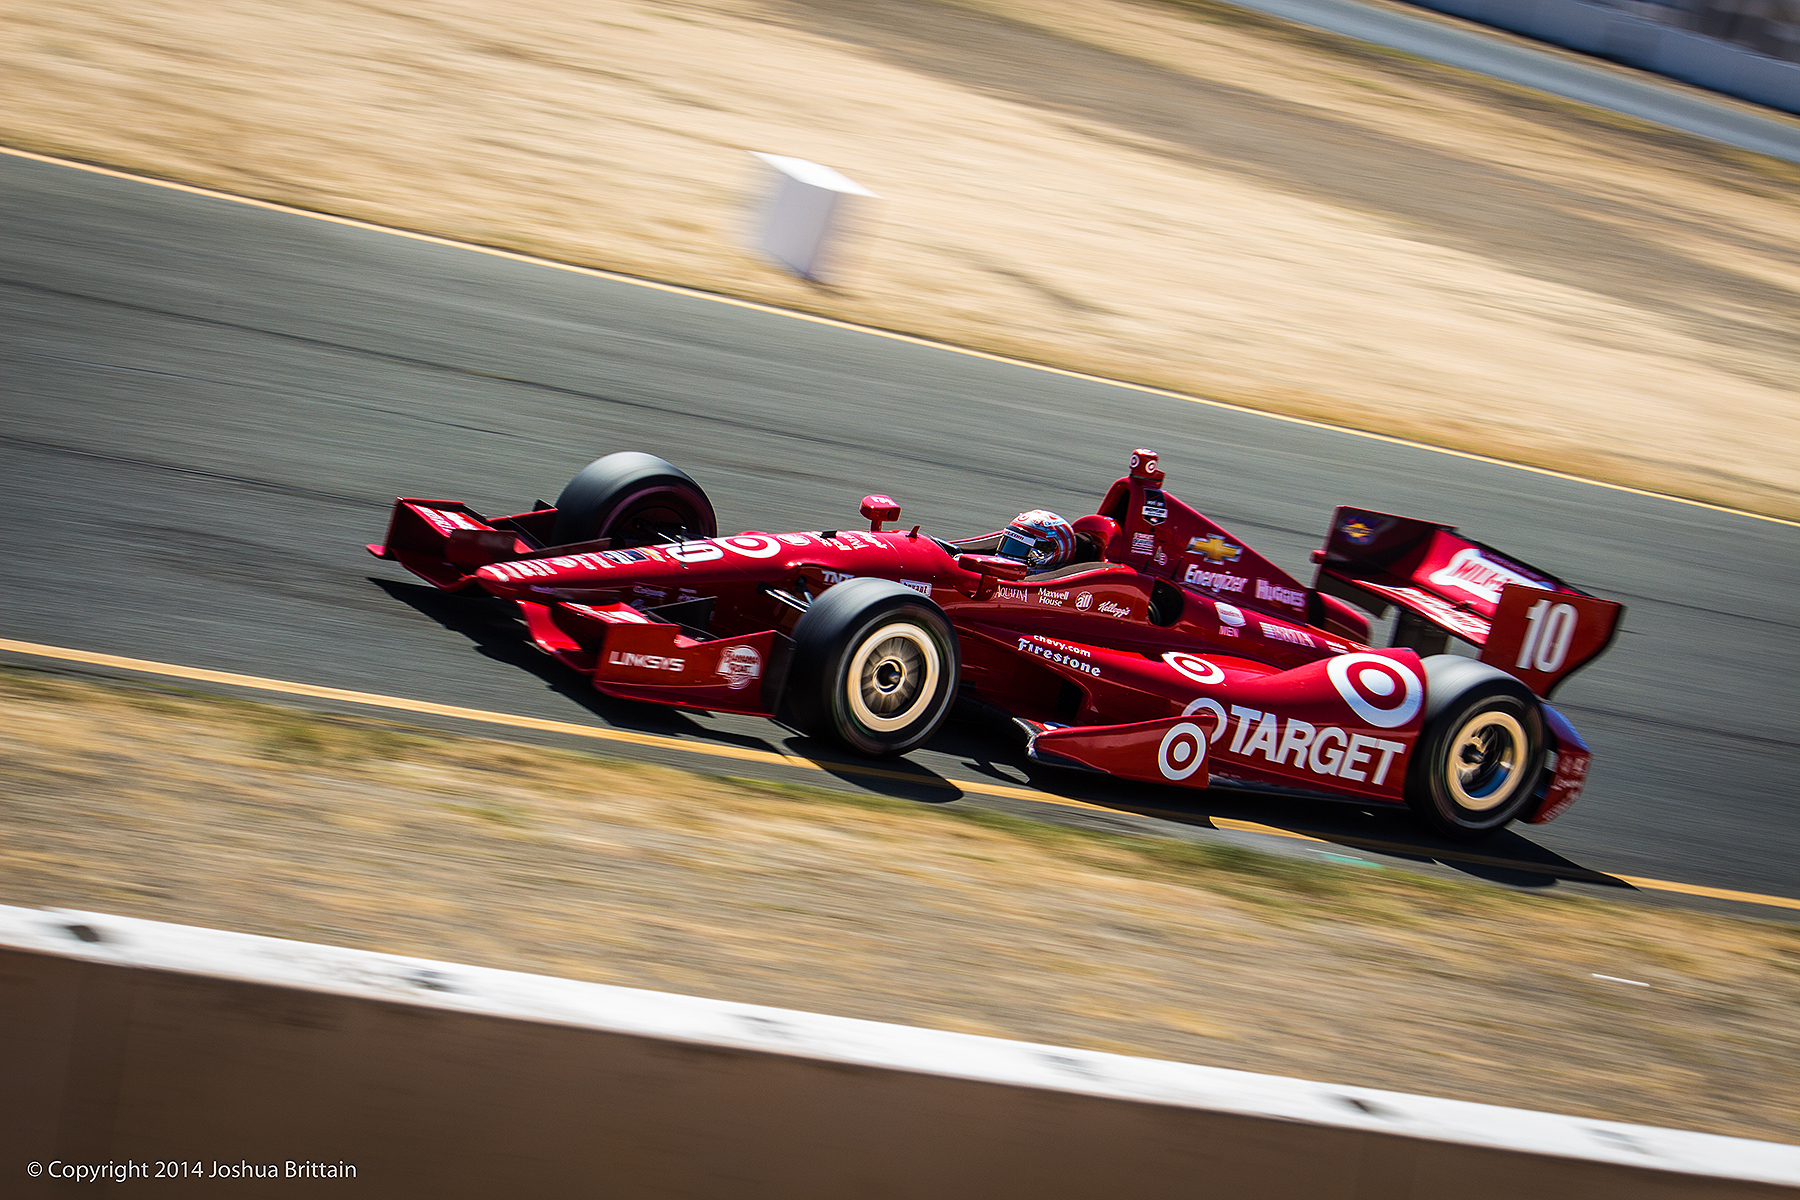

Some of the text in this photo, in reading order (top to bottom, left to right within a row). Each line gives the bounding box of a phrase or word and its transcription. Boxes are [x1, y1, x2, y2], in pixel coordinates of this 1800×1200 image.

[1184, 564, 1249, 593] Energizer
[994, 584, 1028, 603] AQUAFINA
[1037, 587, 1070, 600] Maxwell
[1038, 597, 1063, 608] House
[1076, 595, 1093, 608] all
[1098, 601, 1131, 618] Kellogg's
[1218, 625, 1240, 638] MEN
[1515, 598, 1579, 674] 10
[1033, 634, 1092, 658] chevy.com
[608, 650, 686, 672] LINKSYS
[1017, 637, 1102, 677] Firestone
[1228, 703, 1407, 786] TARGET
